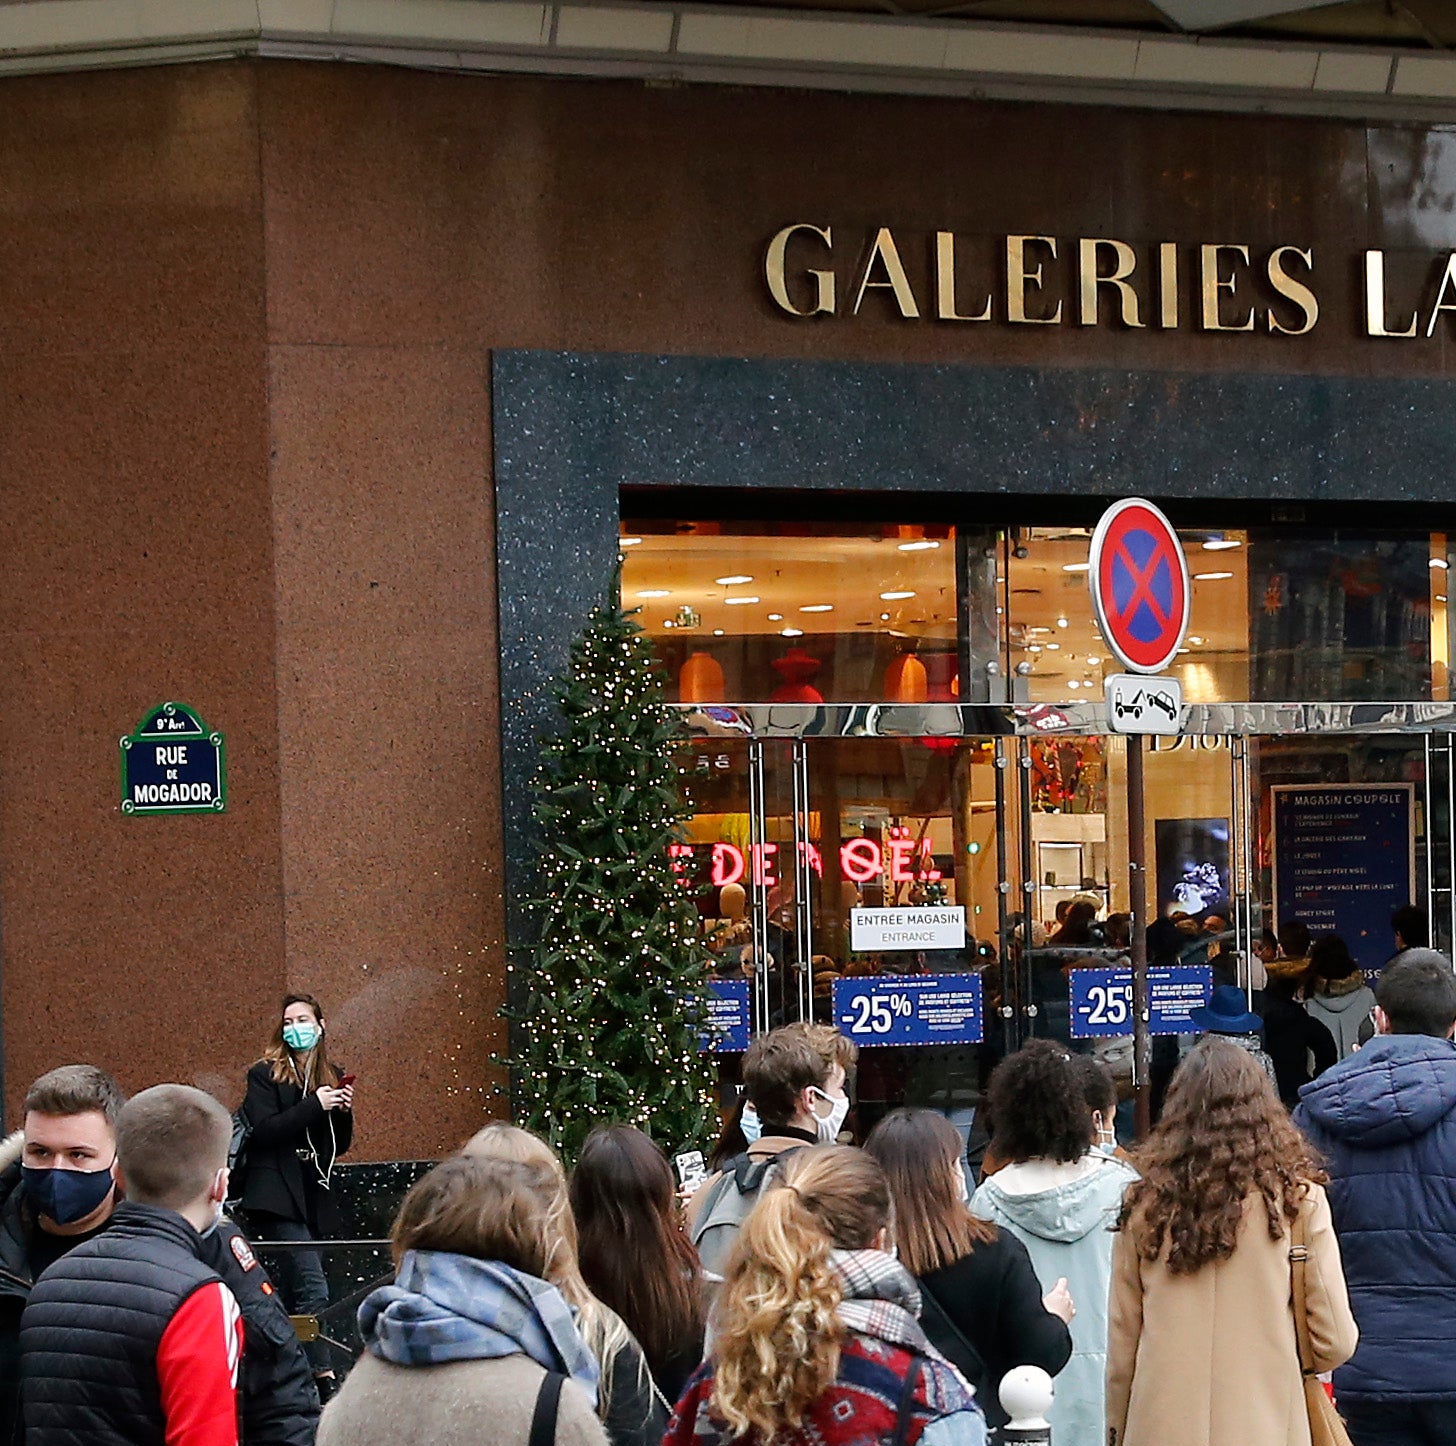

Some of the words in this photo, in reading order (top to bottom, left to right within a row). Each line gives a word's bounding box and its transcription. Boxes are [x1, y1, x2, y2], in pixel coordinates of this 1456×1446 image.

[765, 223, 1320, 336] GALERIES
[155, 746, 188, 765] RUE
[166, 769, 178, 780] DE
[134, 783, 212, 803] MOGADOR
[1295, 796, 1342, 805] MAGASIN
[1344, 794, 1401, 804] COUPOLE
[711, 843, 778, 886] DE
[857, 913, 903, 926] ENTRÉE
[907, 913, 960, 925] MAGASIN
[882, 931, 935, 942] ENTRANCE
[842, 993, 912, 1034] -25%
